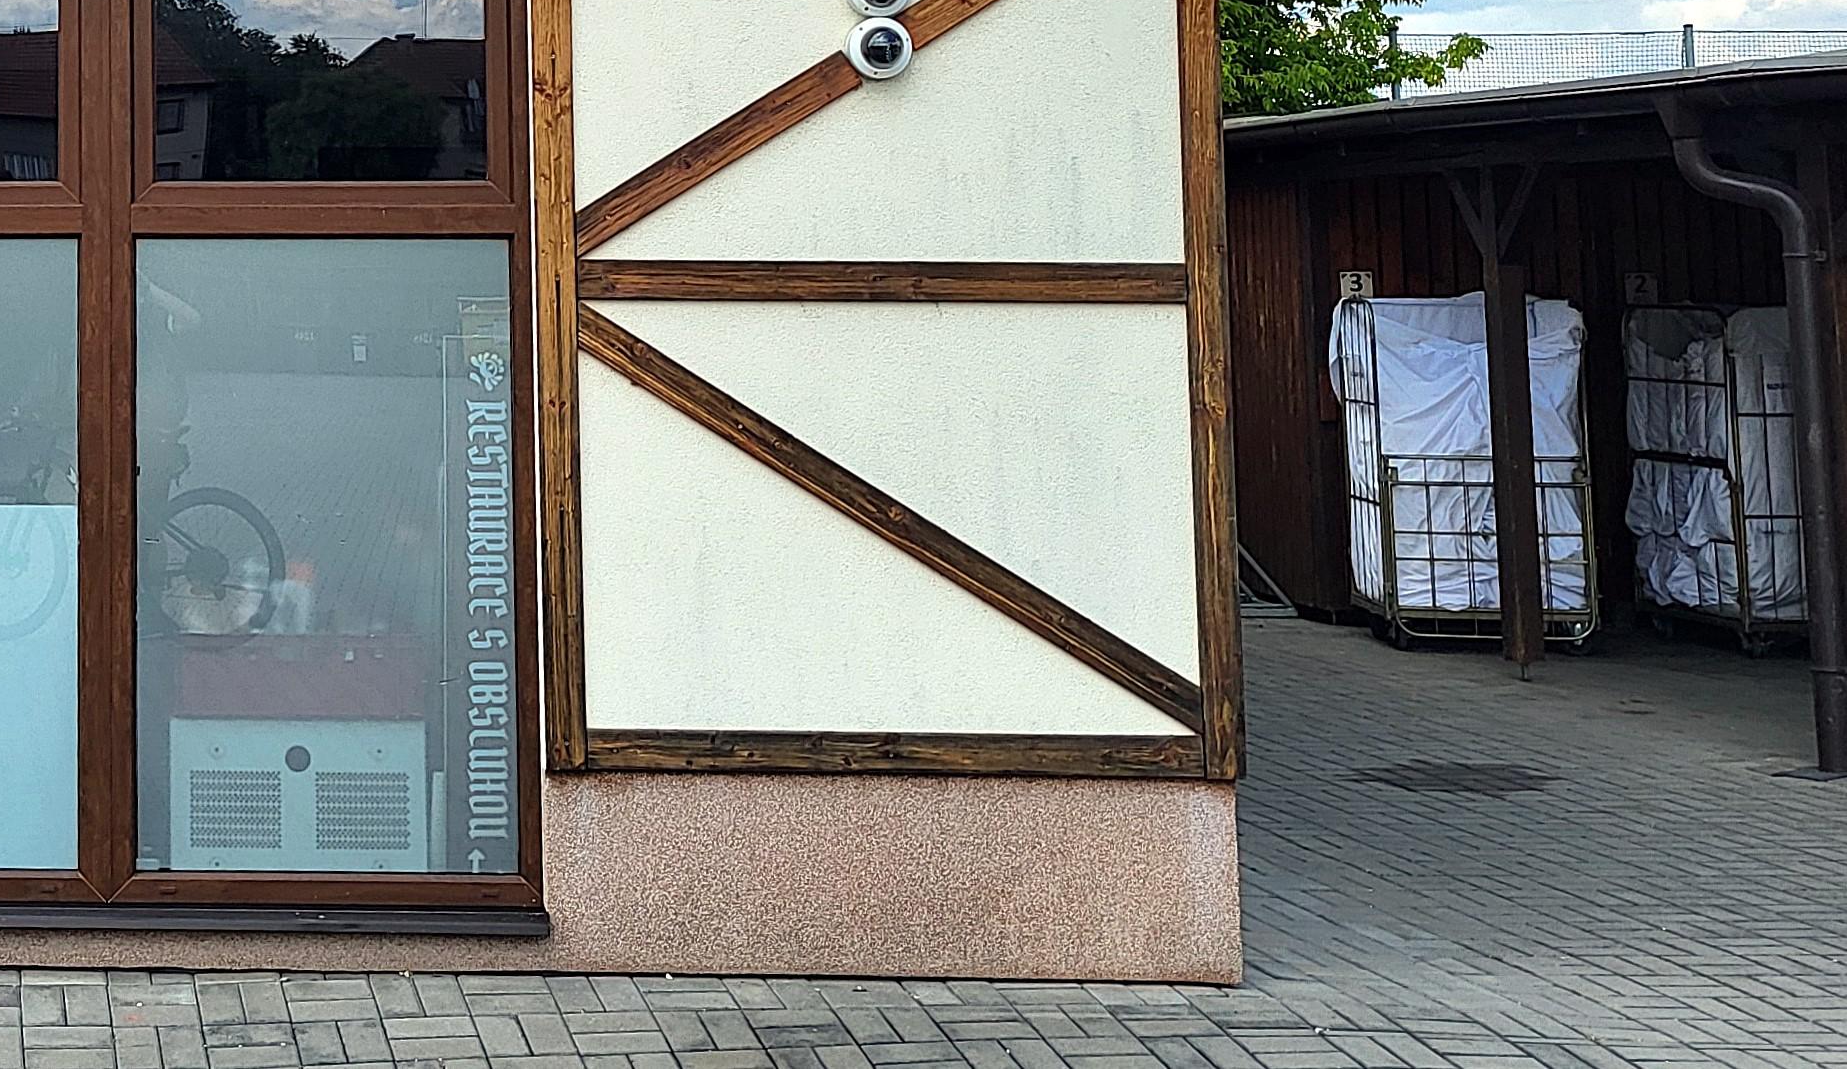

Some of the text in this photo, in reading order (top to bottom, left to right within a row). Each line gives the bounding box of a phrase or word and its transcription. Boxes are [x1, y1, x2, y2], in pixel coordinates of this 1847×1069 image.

[1349, 272, 1364, 293] 3
[1634, 274, 1650, 294] 2
[465, 398, 510, 842] RESTAURACE S OBSLUHOU
